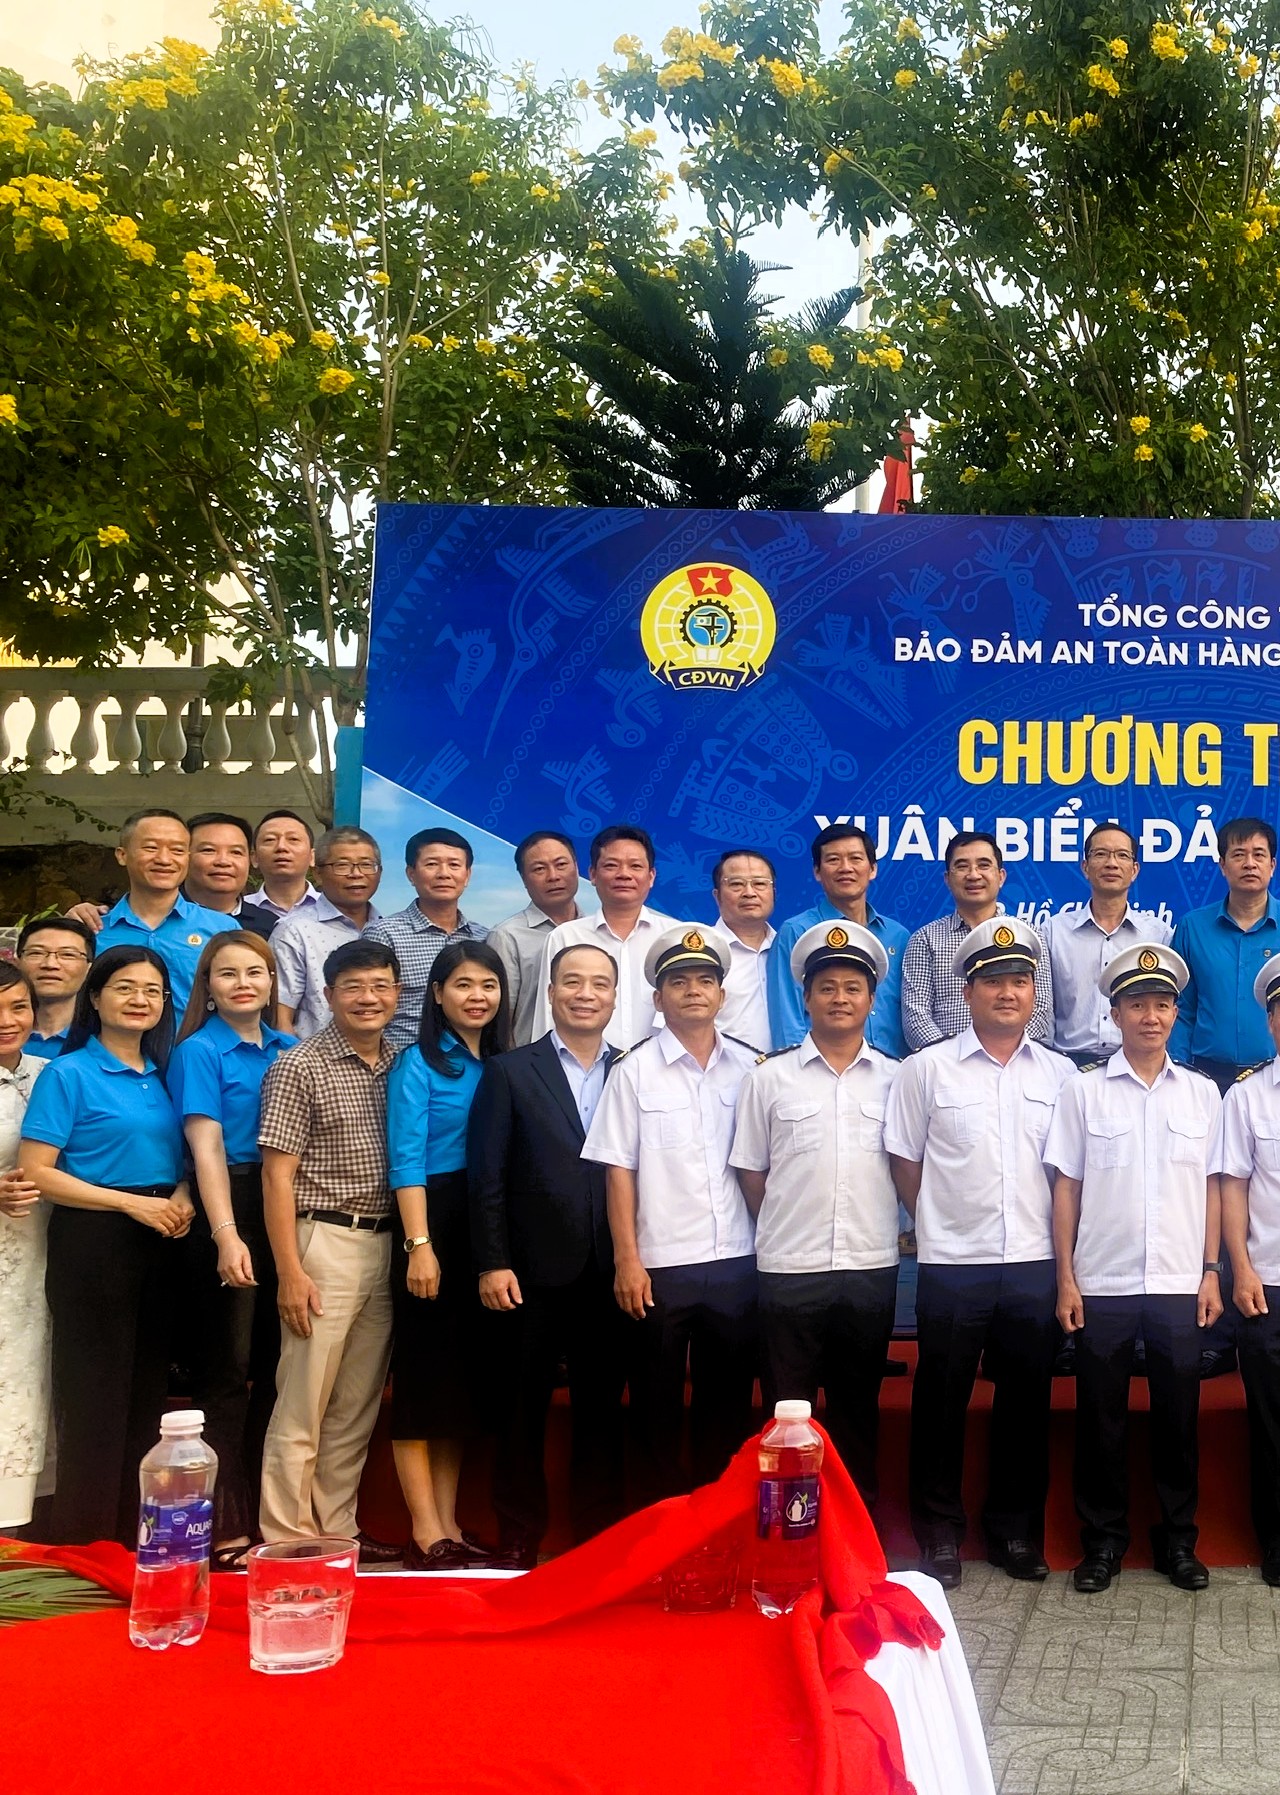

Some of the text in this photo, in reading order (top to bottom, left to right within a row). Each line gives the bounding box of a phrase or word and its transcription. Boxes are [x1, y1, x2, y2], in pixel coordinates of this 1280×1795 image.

[1078, 593, 1168, 628] TỔNG
[1176, 599, 1271, 629] CÔNG
[894, 630, 962, 662] BẢO
[971, 632, 1043, 664] ĐẢM
[1051, 640, 1094, 664] AN
[1103, 636, 1189, 666] TOÀN
[678, 670, 735, 687] CĐVN
[957, 714, 1223, 787] CHƯƠNG
[995, 798, 1120, 862] BIỂ
[1139, 804, 1220, 863] ĐẢ
